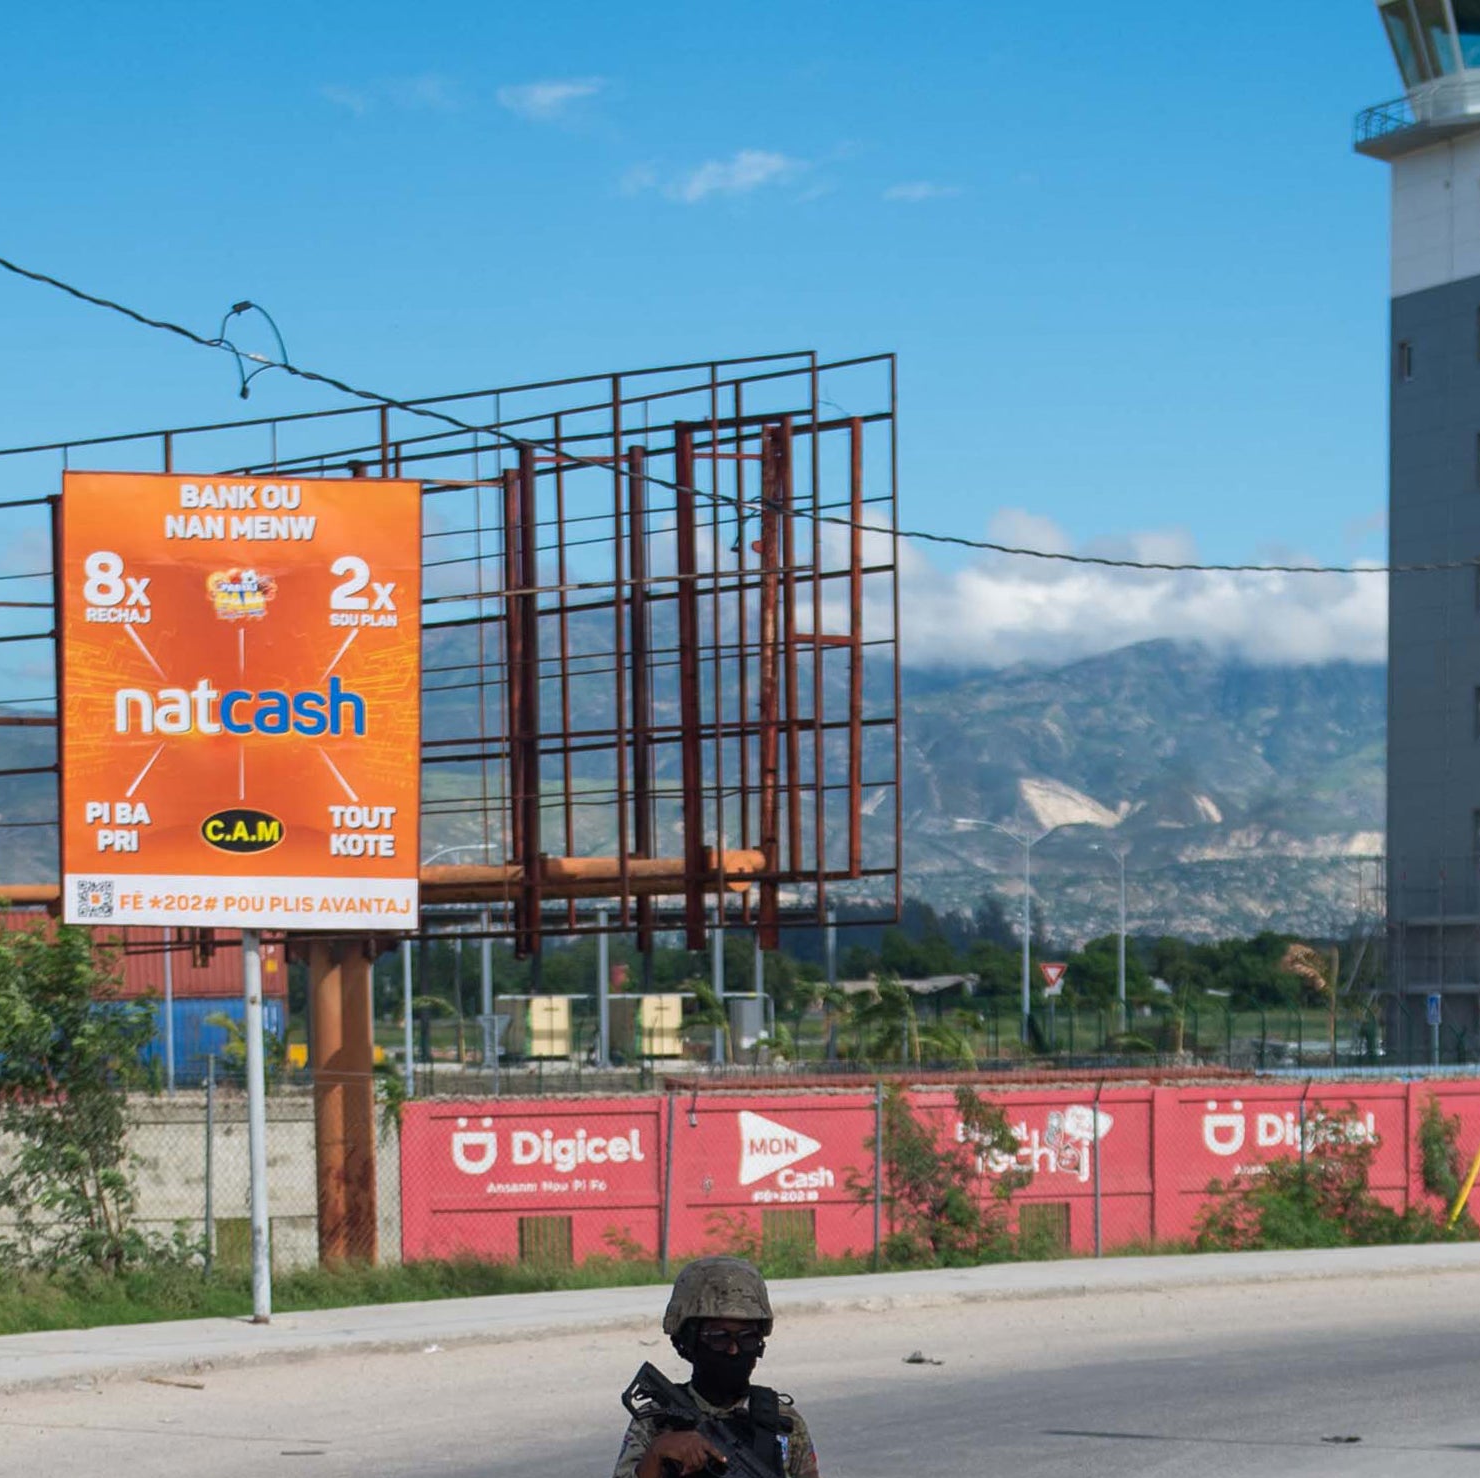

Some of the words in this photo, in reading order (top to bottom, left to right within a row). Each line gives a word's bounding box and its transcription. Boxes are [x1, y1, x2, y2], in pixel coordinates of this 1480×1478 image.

[180, 484, 258, 509] BANK
[261, 485, 301, 509] OU
[165, 514, 226, 539] NAN
[230, 516, 316, 541] MENW
[85, 607, 151, 623] RECHAJ
[329, 613, 359, 627] SOU
[361, 614, 398, 628] PLAN
[116, 676, 366, 736] natcash
[86, 801, 110, 825] PI
[115, 802, 151, 825] BA
[329, 806, 396, 828] TOUT
[97, 829, 139, 852] PRI
[205, 820, 280, 842] C.A.M
[331, 834, 395, 857] KOTE
[224, 896, 265, 912] POU
[269, 896, 315, 913] PLIS
[319, 897, 411, 914] AVANTAJ
[511, 1129, 645, 1172] Digicel
[749, 1138, 799, 1155] MON
[778, 1166, 835, 1189] Cash
